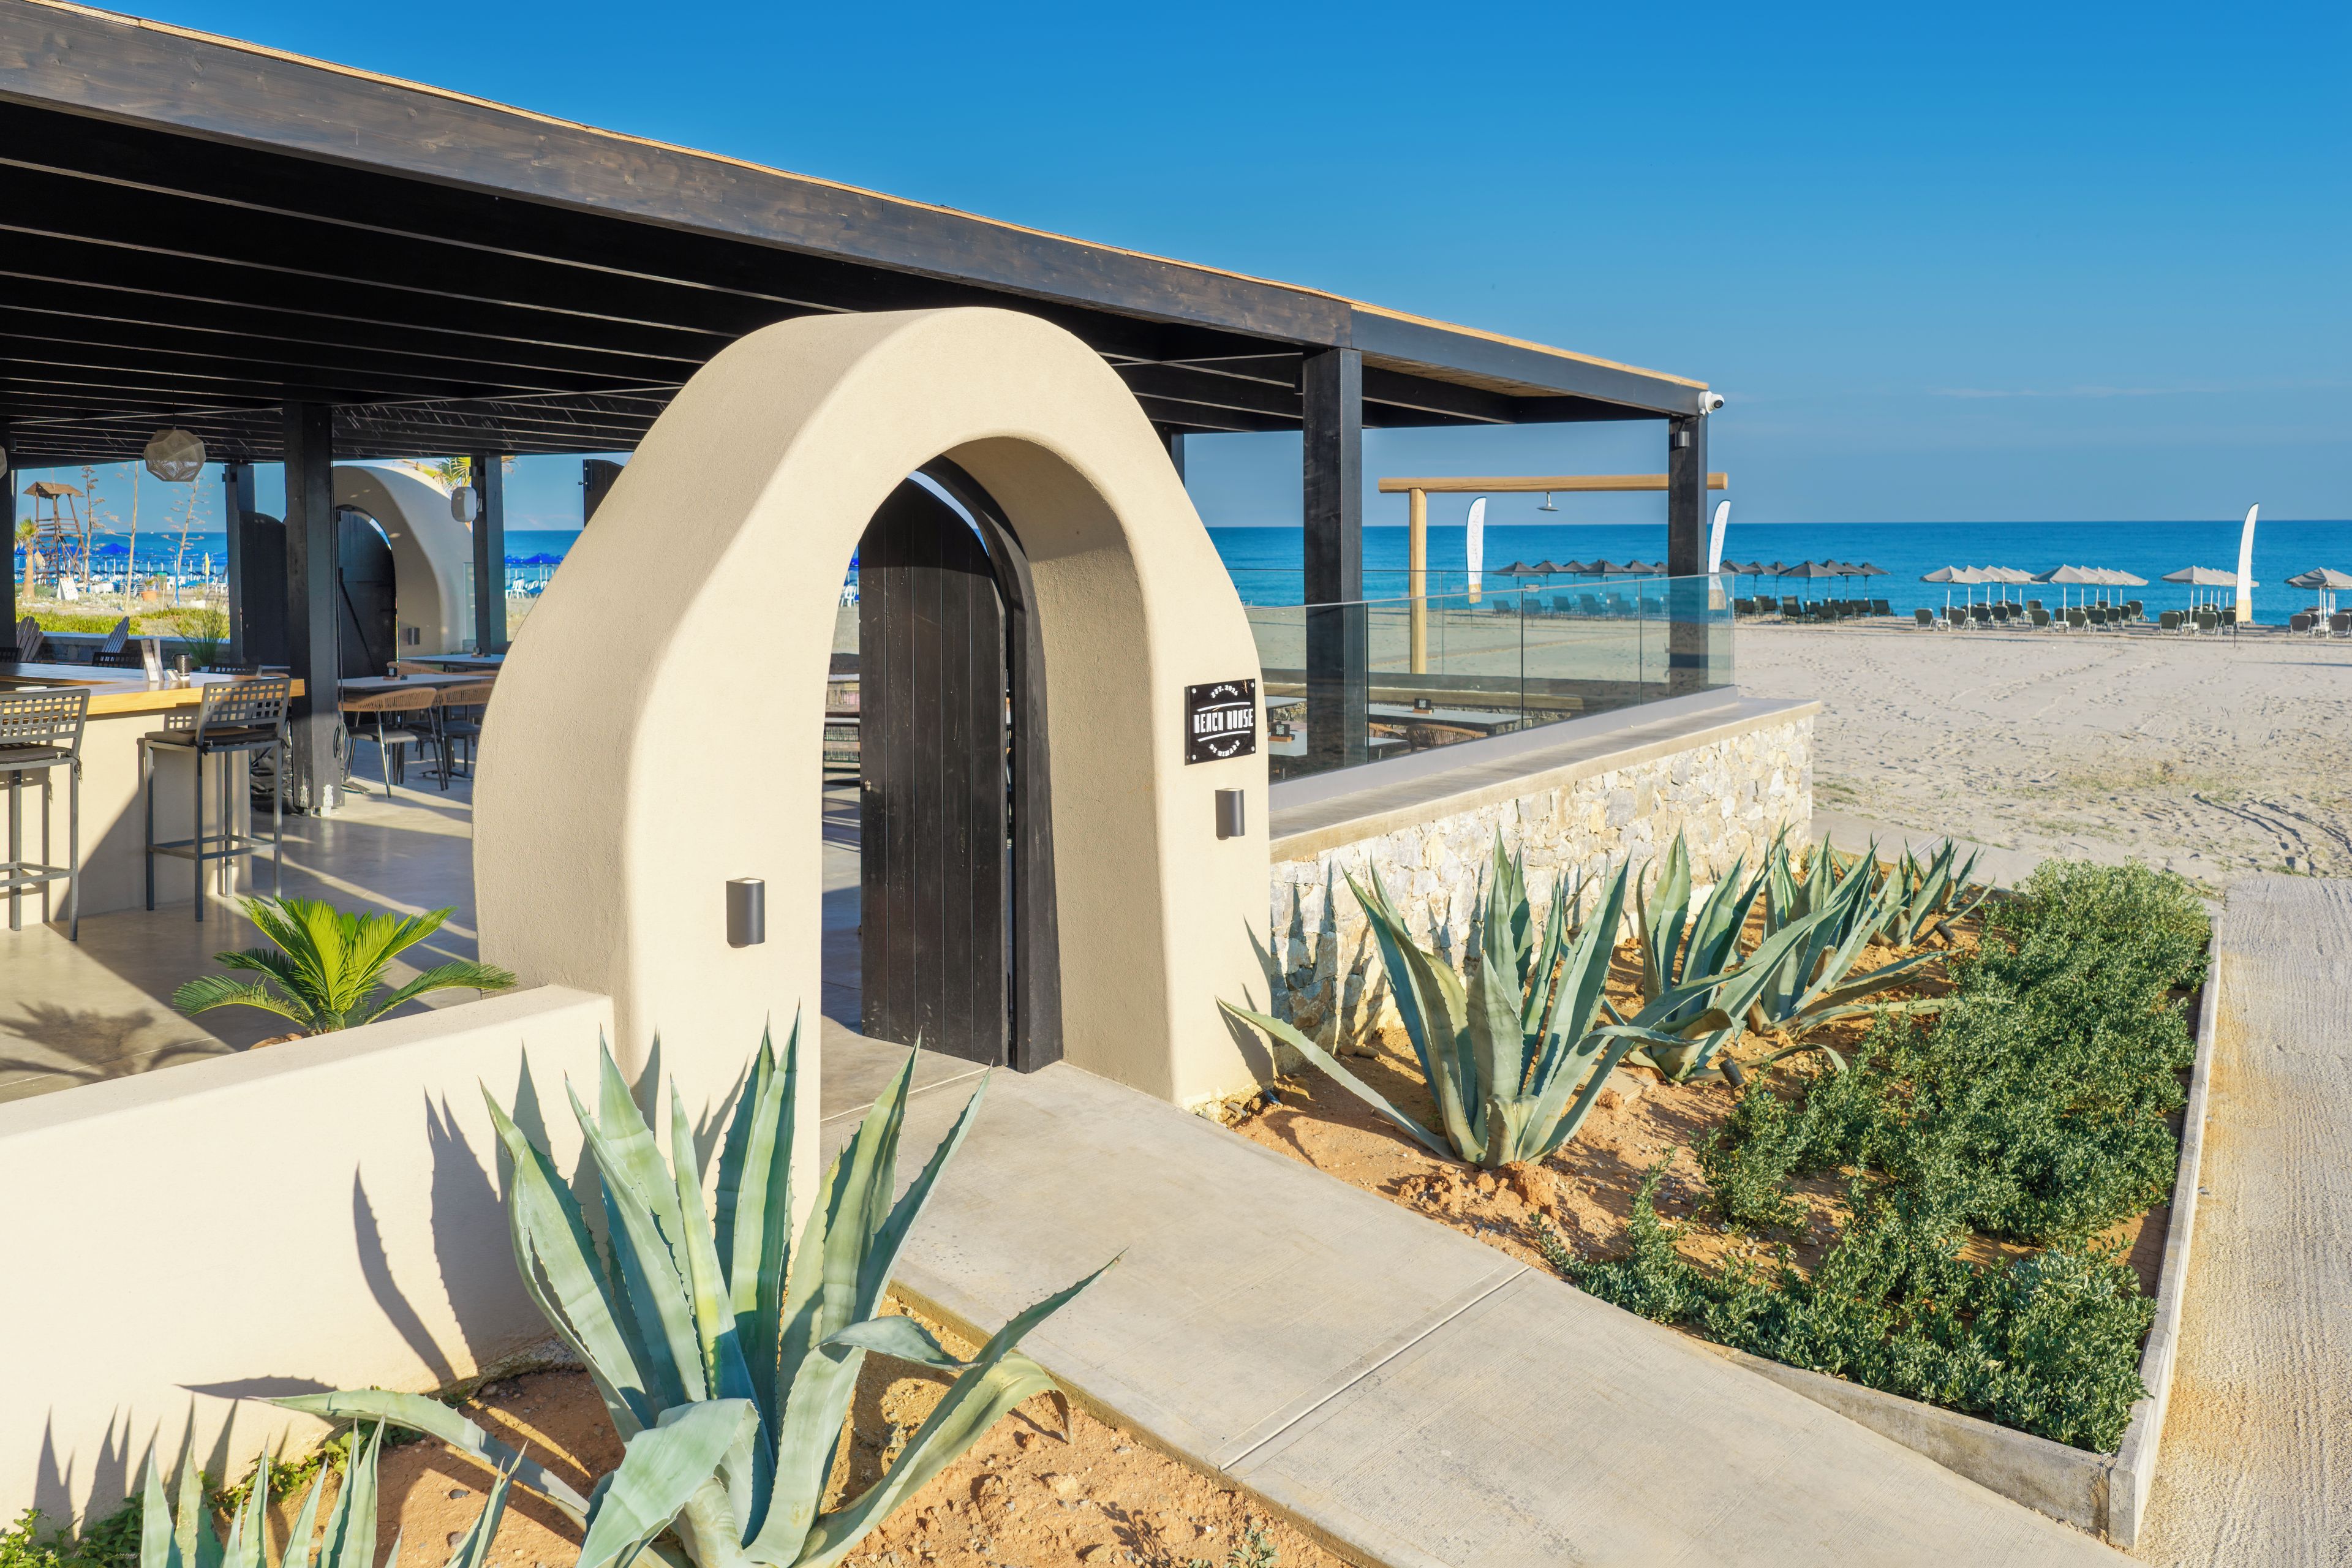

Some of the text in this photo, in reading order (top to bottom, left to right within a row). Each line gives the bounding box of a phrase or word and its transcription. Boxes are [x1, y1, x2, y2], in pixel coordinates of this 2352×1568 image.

[1210, 685, 1224, 698] EST.
[1194, 709, 1254, 734] BEACH HOUSE
[1209, 744, 1218, 753] BY
